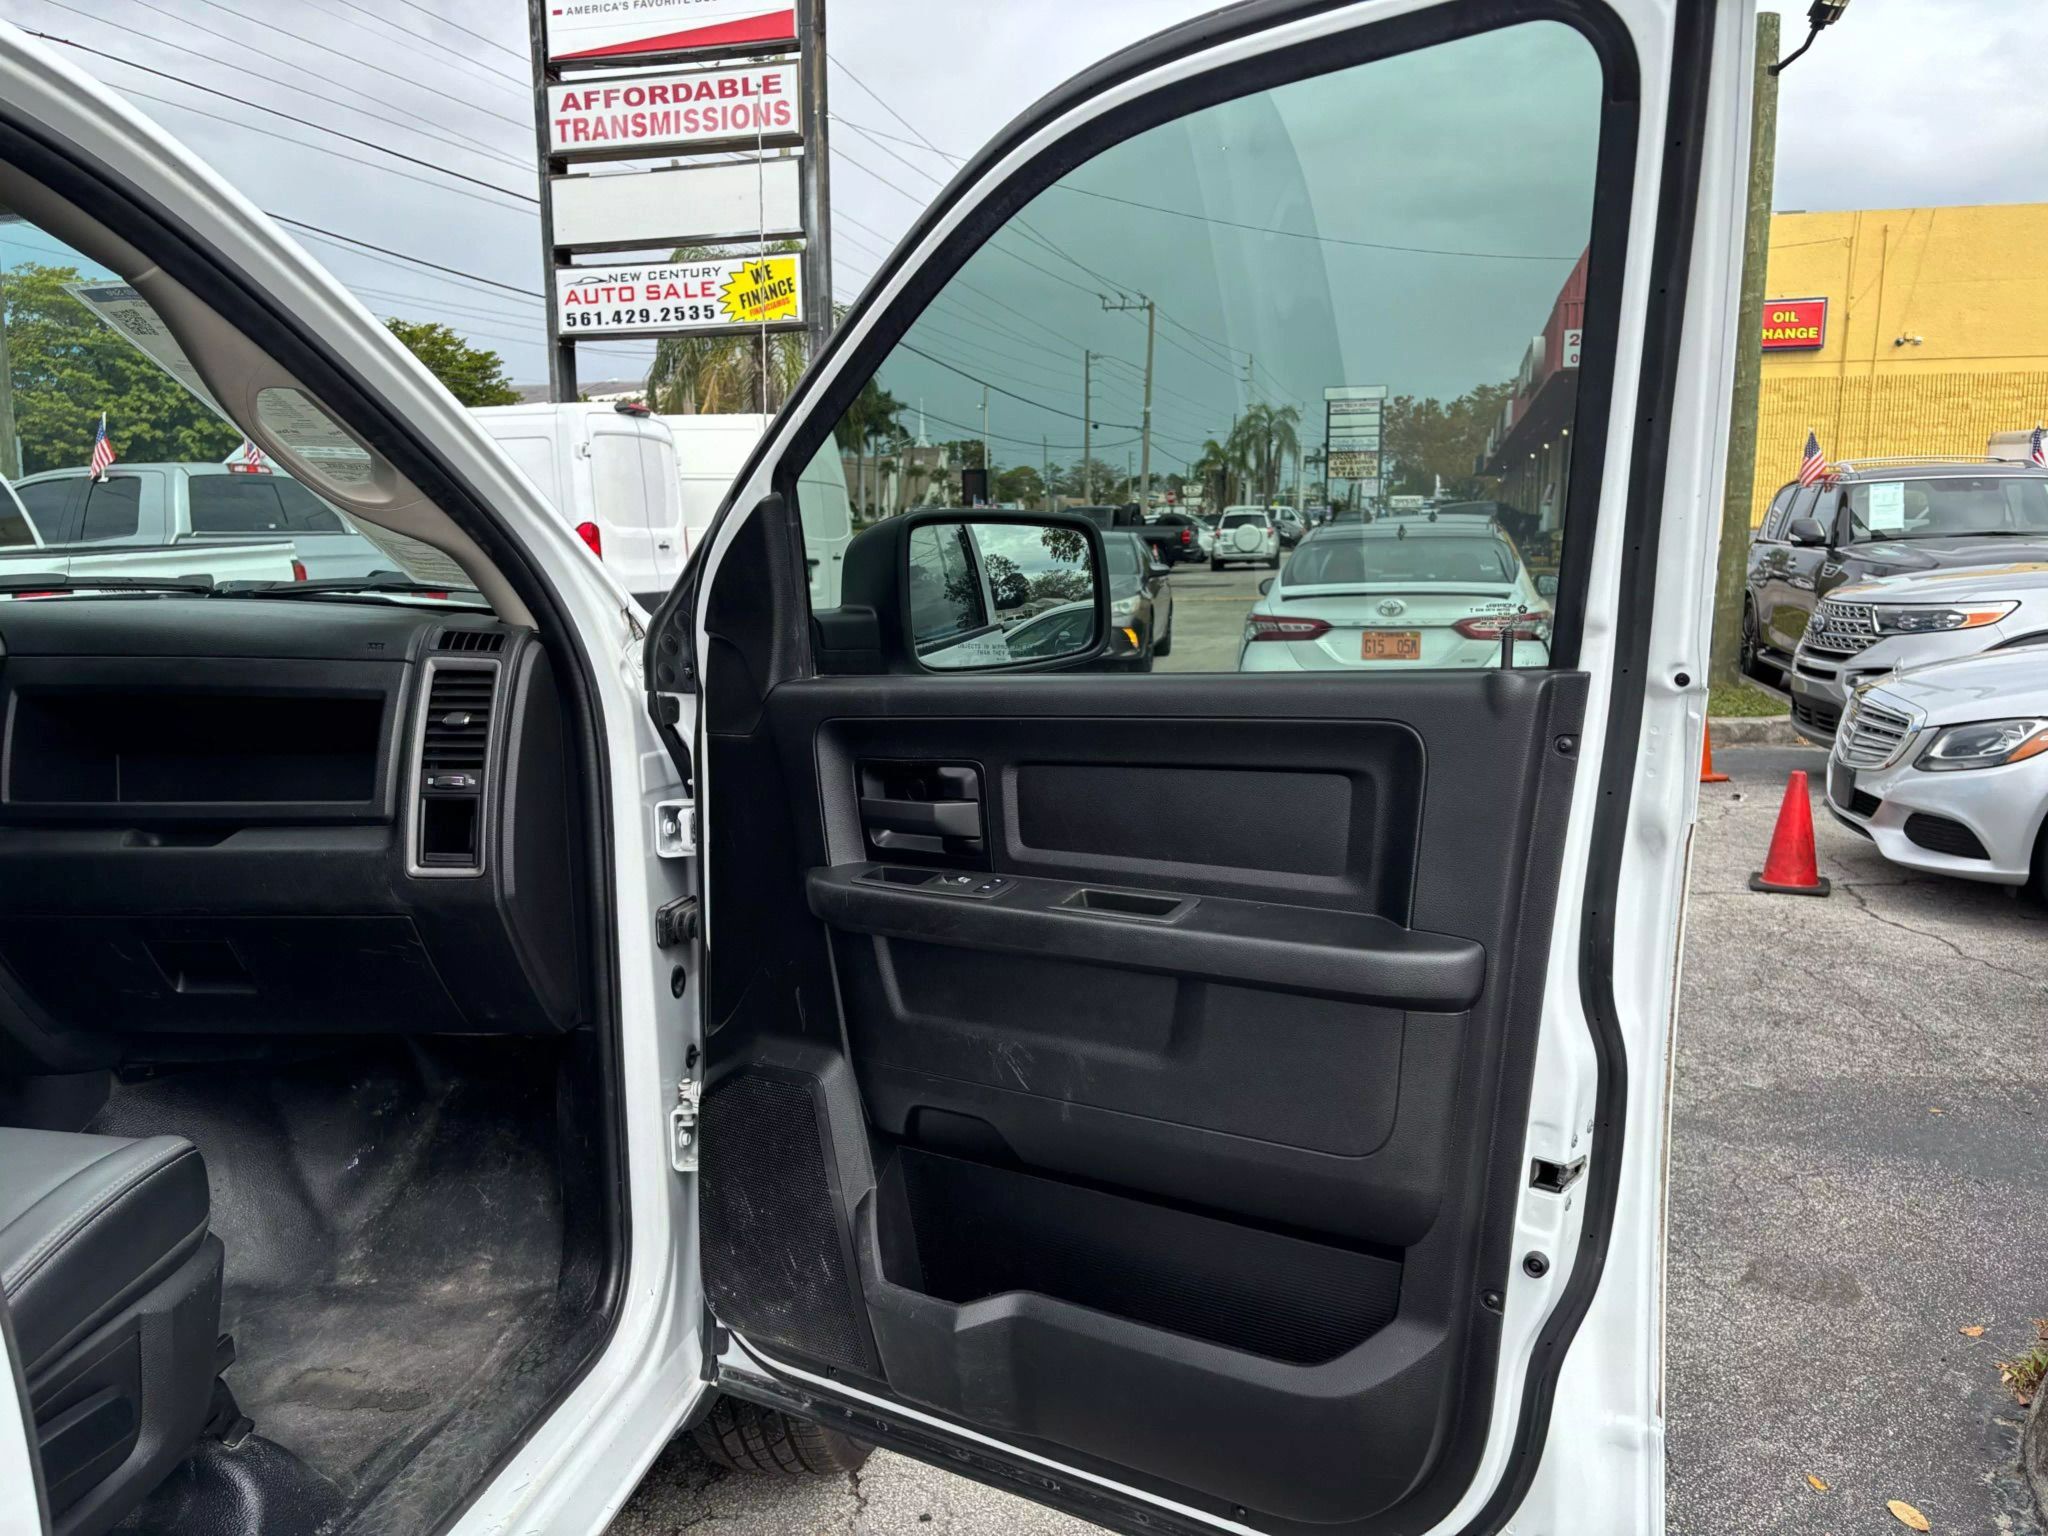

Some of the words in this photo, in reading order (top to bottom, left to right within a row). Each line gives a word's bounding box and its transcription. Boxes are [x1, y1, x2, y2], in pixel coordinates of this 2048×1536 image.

[566, 1, 630, 16] AMERICA'S
[560, 74, 782, 112] AFFORDABLE
[555, 100, 791, 143] TRANSMISSIONS
[608, 272, 642, 283] NEW
[648, 267, 722, 280] CENTURY
[750, 264, 774, 285] WE
[565, 286, 635, 305] AUTO
[646, 281, 716, 301] SALE
[739, 277, 796, 310] FINANCE
[566, 305, 715, 327] 561.429.2535
[1772, 311, 1800, 323] OIL
[1762, 327, 1819, 340] HANGE
